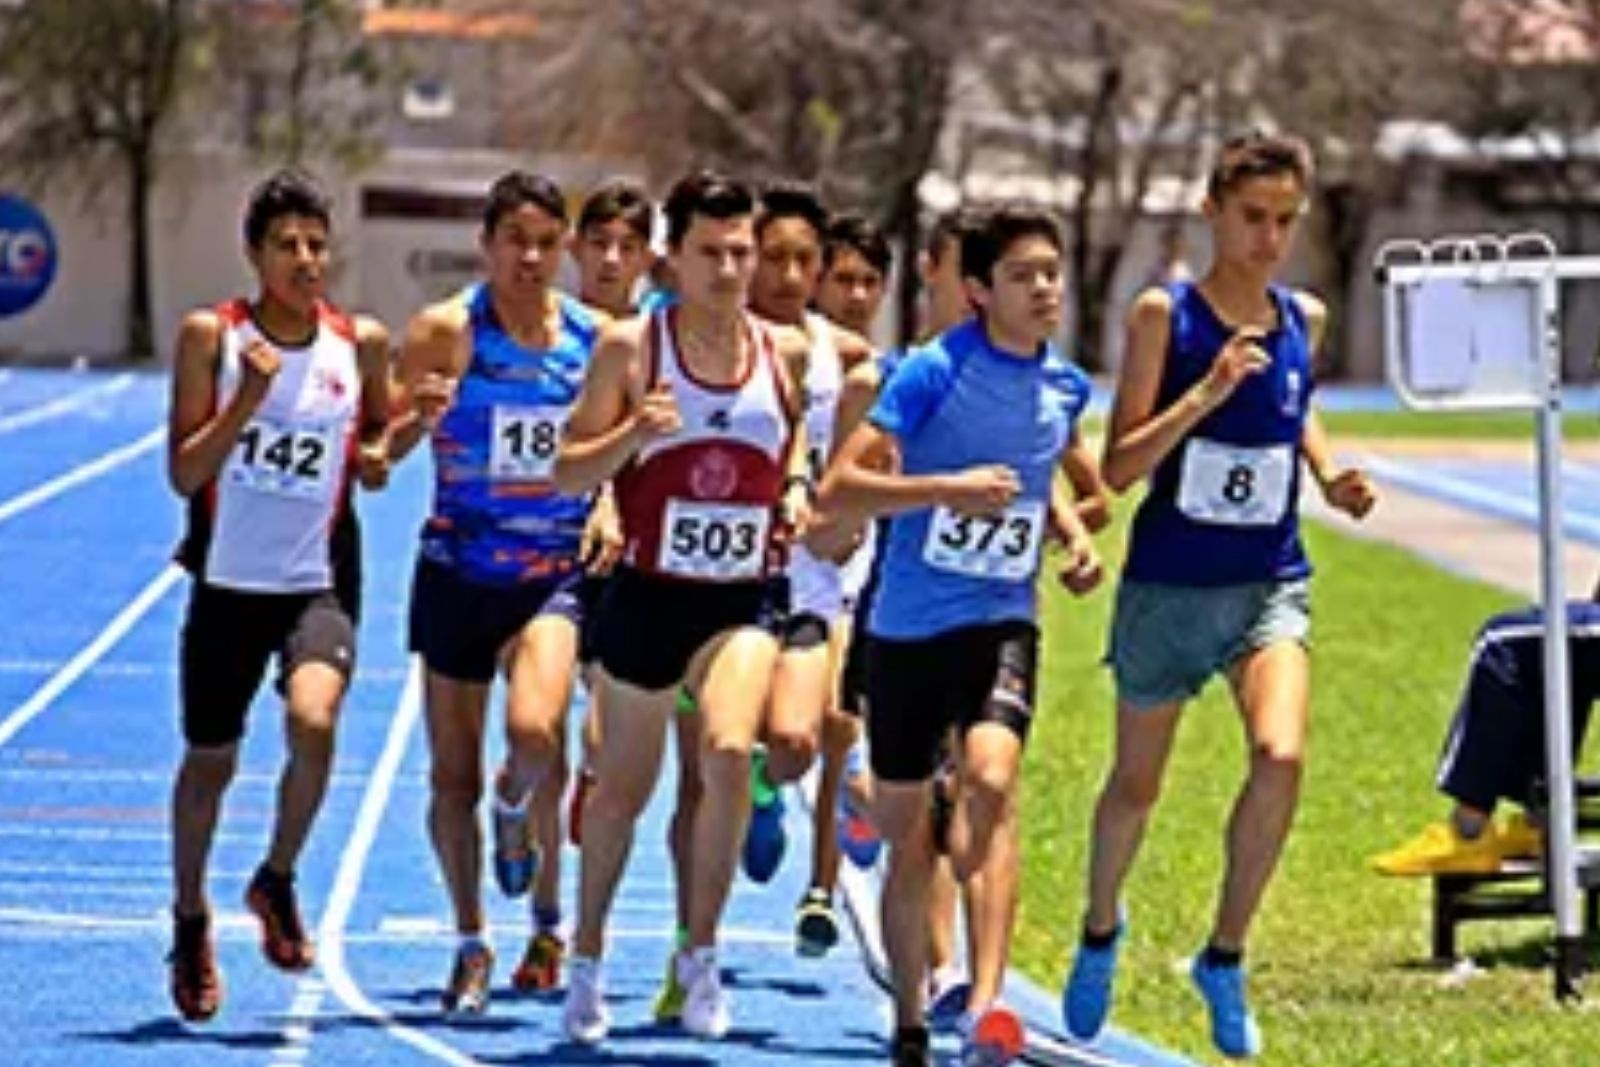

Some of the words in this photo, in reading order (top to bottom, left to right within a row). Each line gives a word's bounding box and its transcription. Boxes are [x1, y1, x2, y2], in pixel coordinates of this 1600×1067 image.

[237, 427, 325, 478] 142
[501, 421, 569, 458] 18
[1222, 465, 1254, 505] 8
[671, 518, 757, 560] 503
[940, 516, 1032, 557] 373
